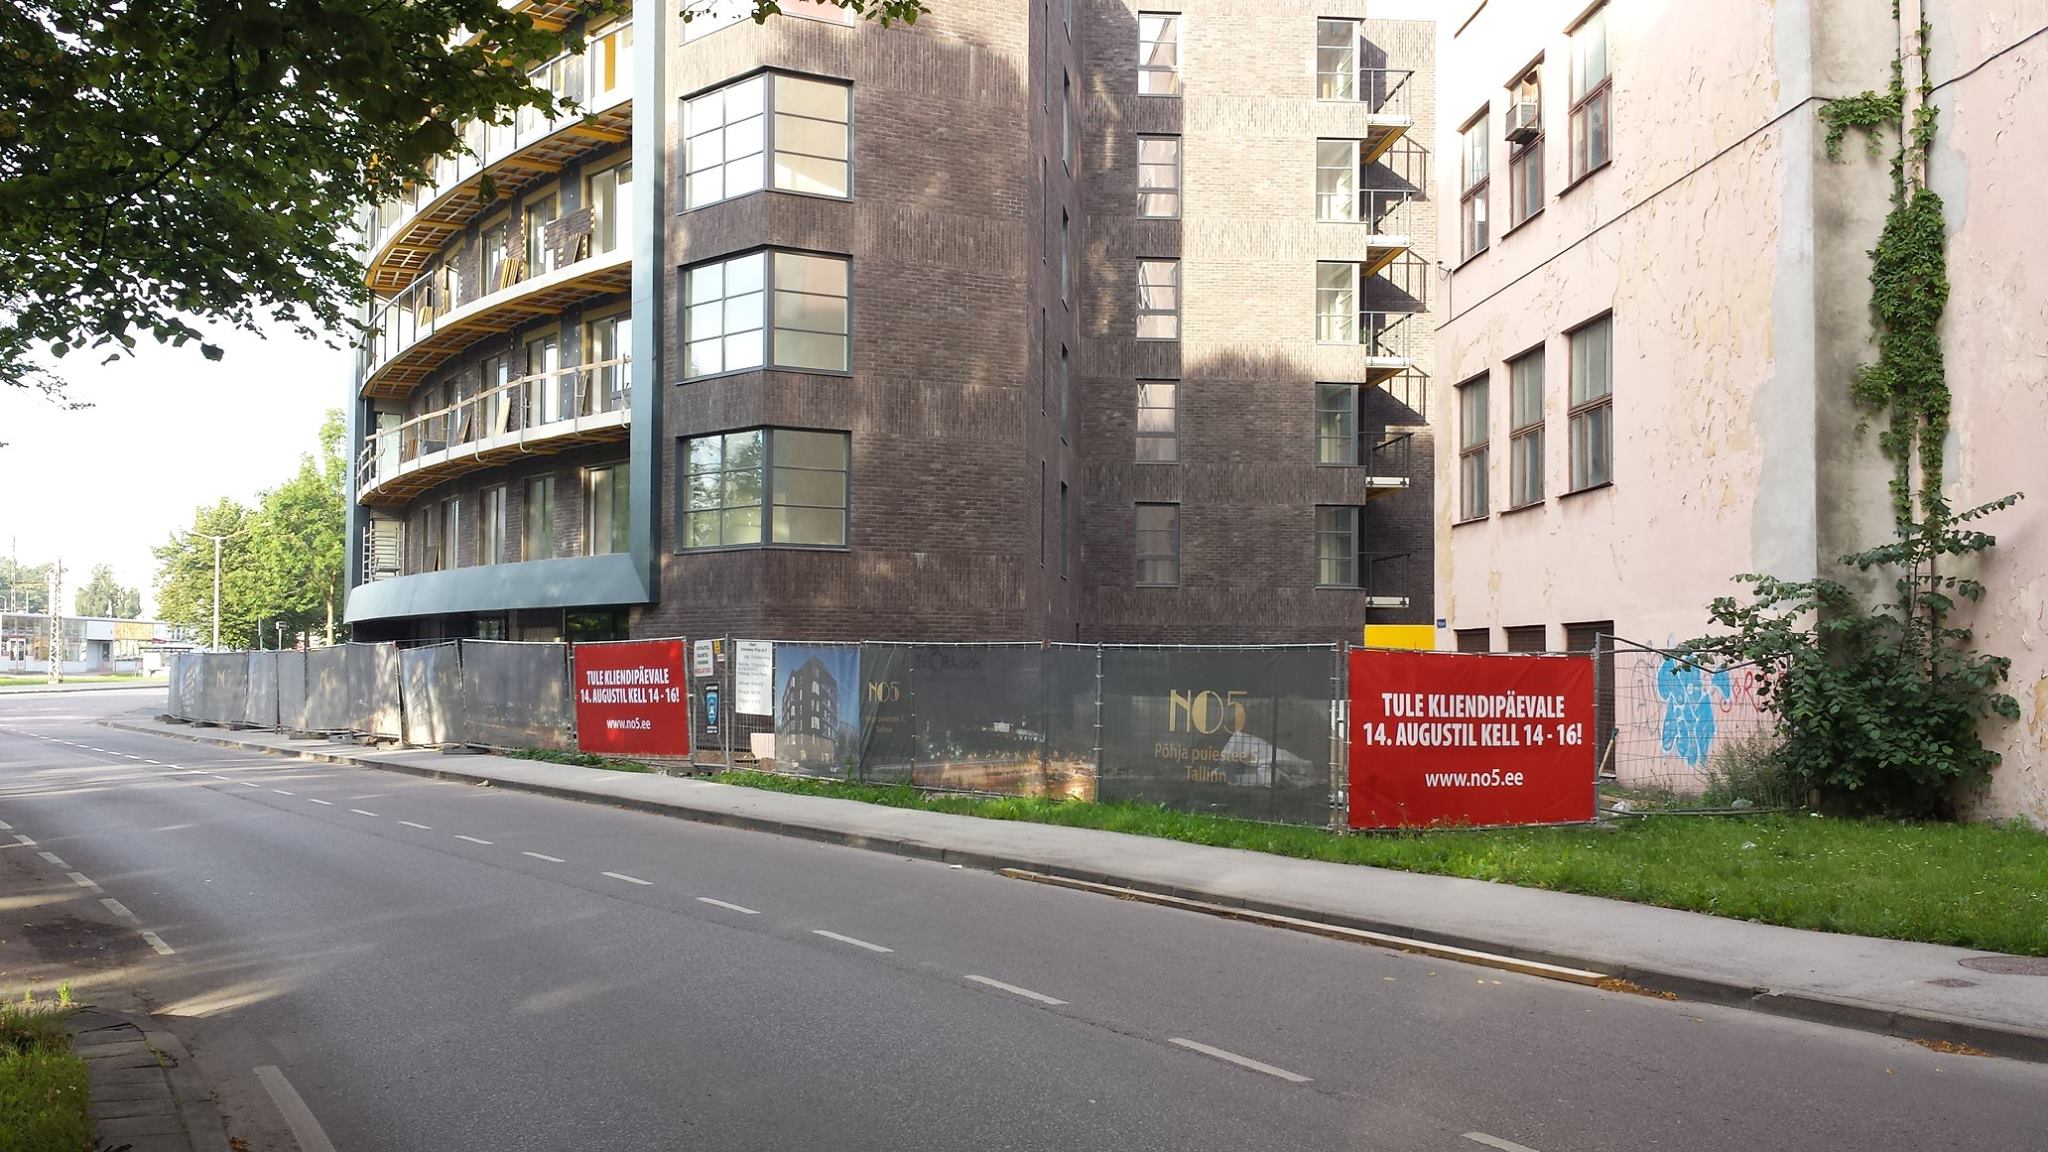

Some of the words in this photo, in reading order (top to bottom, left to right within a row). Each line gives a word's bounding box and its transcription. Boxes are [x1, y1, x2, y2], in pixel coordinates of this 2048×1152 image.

[586, 670, 604, 686] TULE
[604, 665, 670, 686] KLIENDIPÄEVALE
[581, 688, 592, 703] 14.
[592, 688, 627, 703] AUGUSTIL
[628, 688, 647, 703] KELL
[648, 688, 660, 703] 14
[666, 687, 680, 703] 16!
[868, 681, 901, 703] NO5
[1168, 689, 1248, 735] NO5
[1381, 692, 1424, 718] TULE
[1428, 690, 1565, 719] KLIENDIPÄEVALE
[606, 717, 651, 730] www.no5.ee
[1363, 722, 1392, 746] 14.
[1396, 722, 1477, 747] AUGUSTIL
[1481, 722, 1519, 747] KELL
[1523, 723, 1544, 746] 14
[1557, 722, 1583, 746] 16!
[1154, 743, 1188, 762] Põhja
[1191, 744, 1247, 763] puiestee
[1184, 765, 1228, 783] Tallinn
[1425, 768, 1524, 788] www.no5.ee
